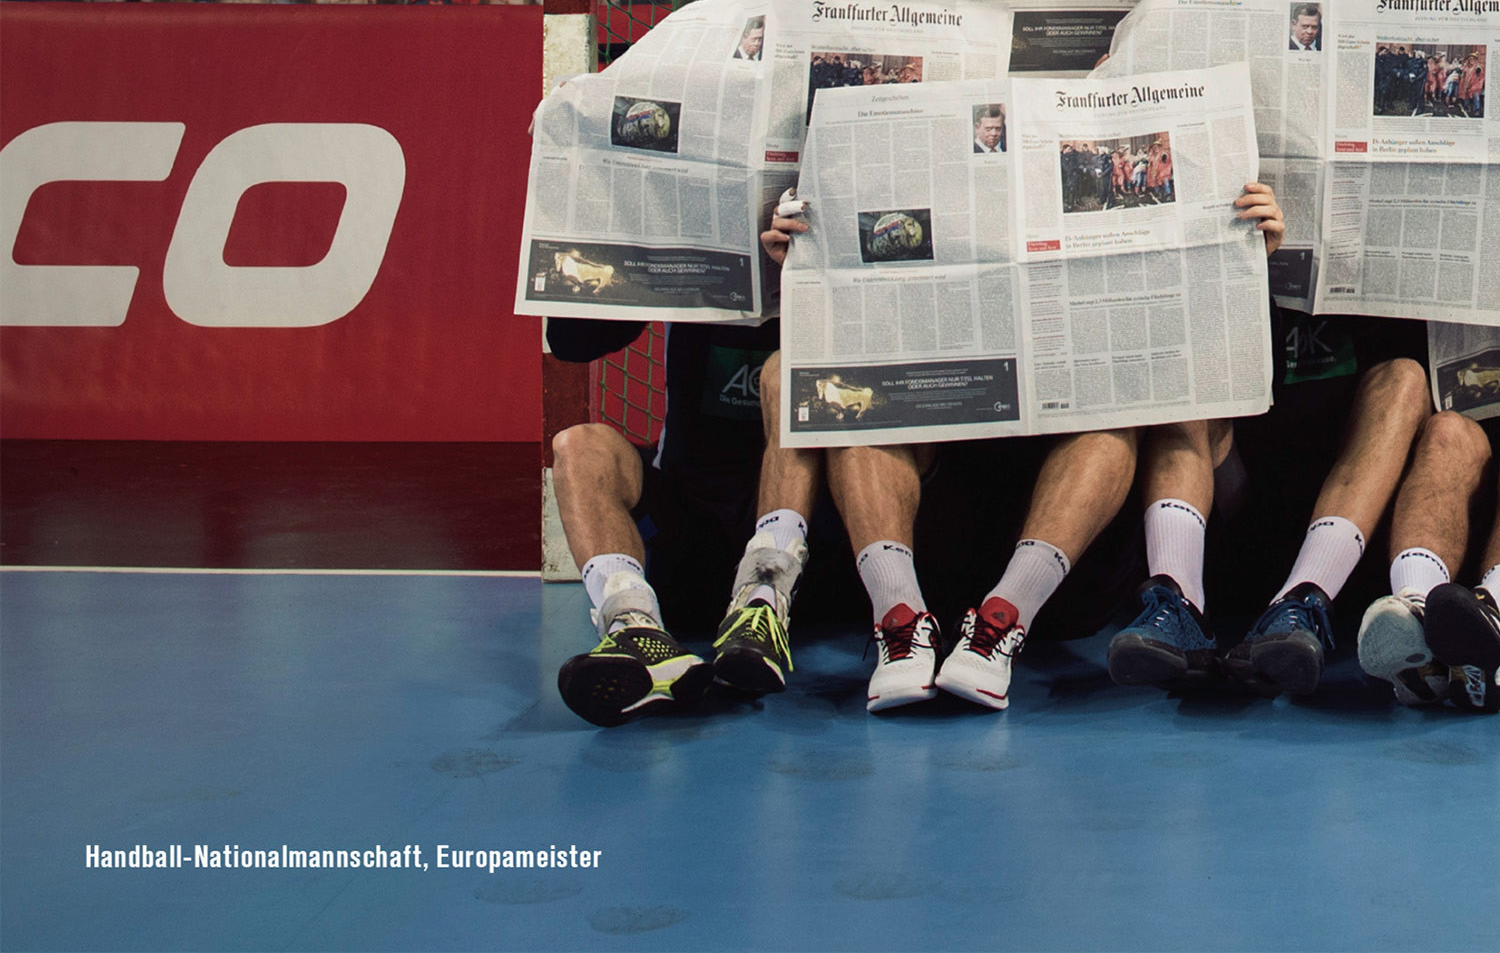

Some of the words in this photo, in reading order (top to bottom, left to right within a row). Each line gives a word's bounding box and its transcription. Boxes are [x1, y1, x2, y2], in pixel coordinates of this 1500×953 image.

[812, 0, 889, 22] Frankfurter
[889, 5, 963, 27] Allgemeine
[1056, 91, 1129, 112] Frankfurter
[1130, 83, 1205, 108] Allgemeine
[0, 120, 407, 327] CO
